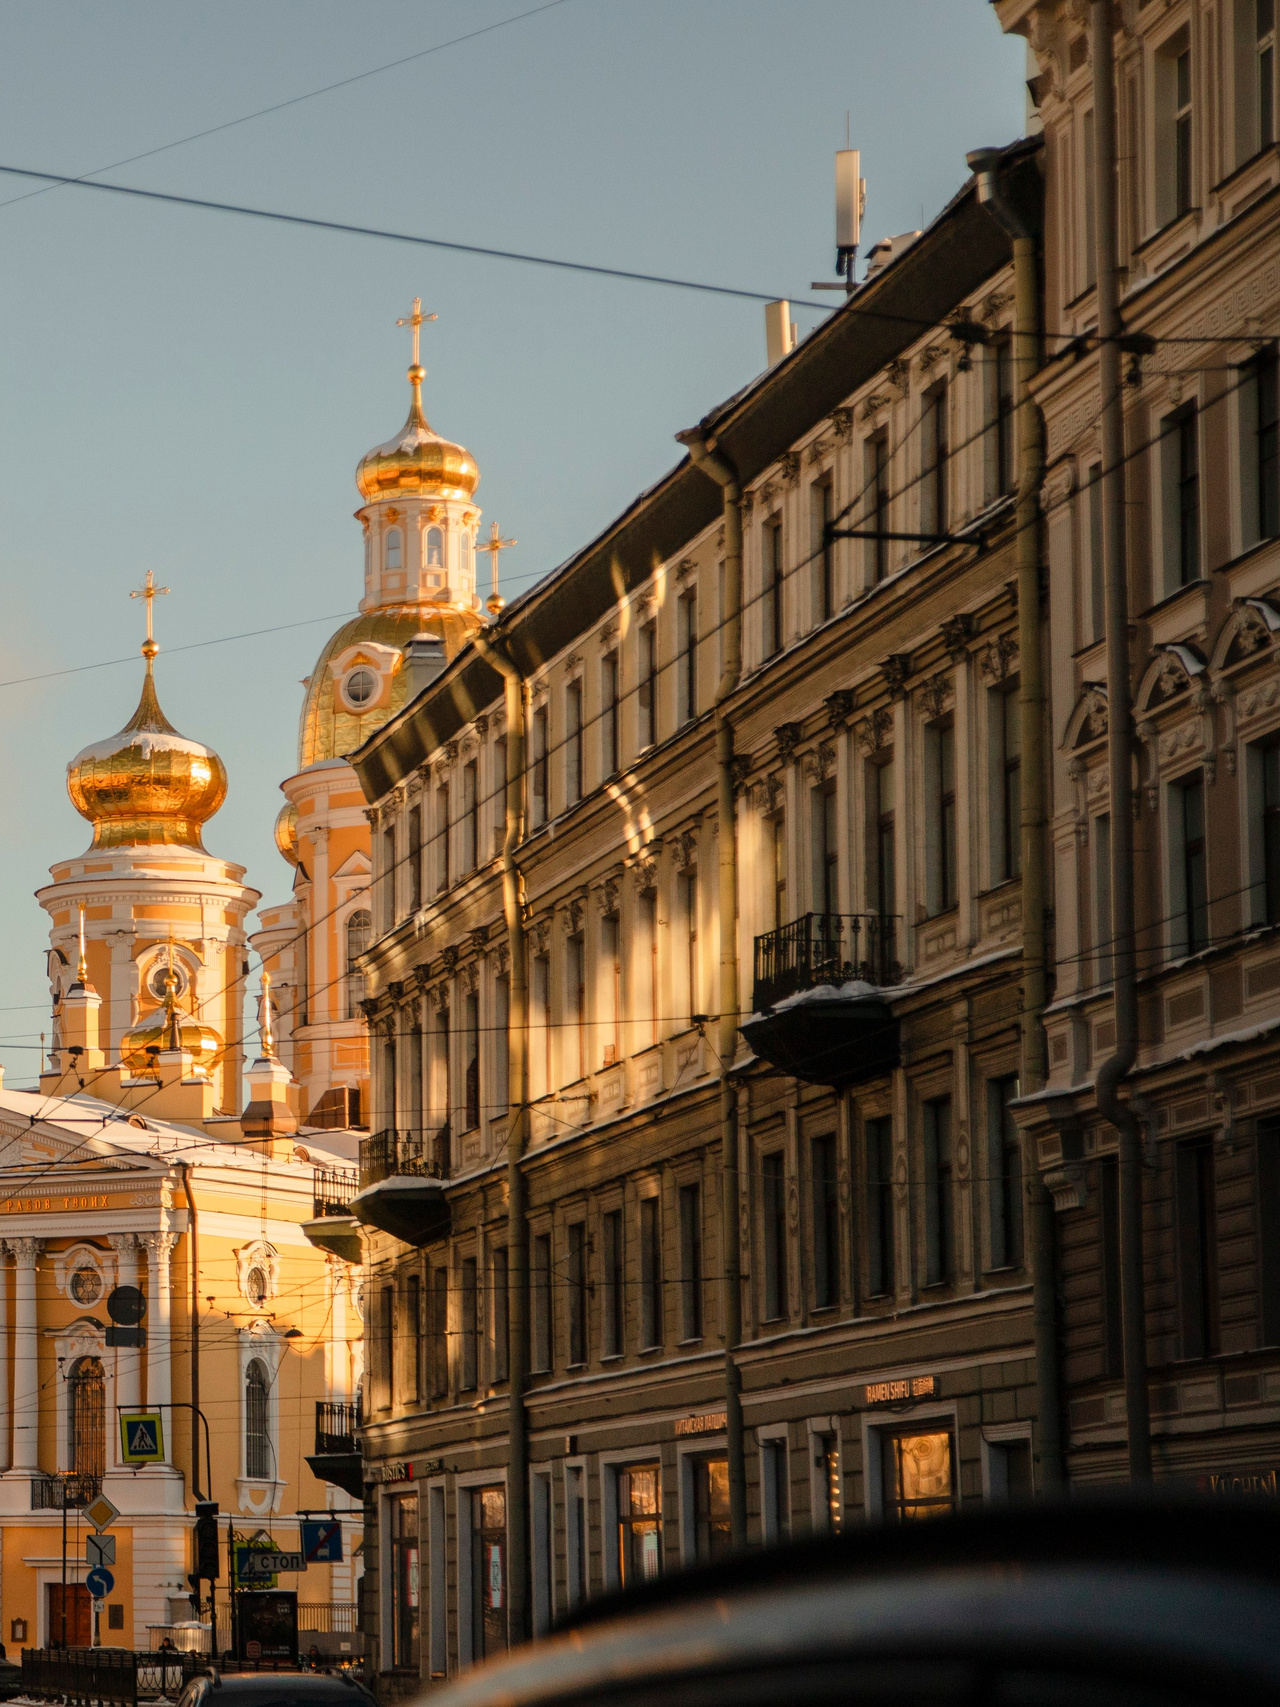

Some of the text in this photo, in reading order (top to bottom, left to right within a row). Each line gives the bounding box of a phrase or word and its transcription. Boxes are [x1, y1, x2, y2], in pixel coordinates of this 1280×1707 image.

[6, 1199, 51, 1212] РАБОВ
[63, 1195, 109, 1209] ТВОИХ
[867, 1380, 910, 1403] RAMEN SHIFU
[705, 1412, 728, 1431] ЛАПШИЧ
[261, 1556, 299, 1569] СТОП
